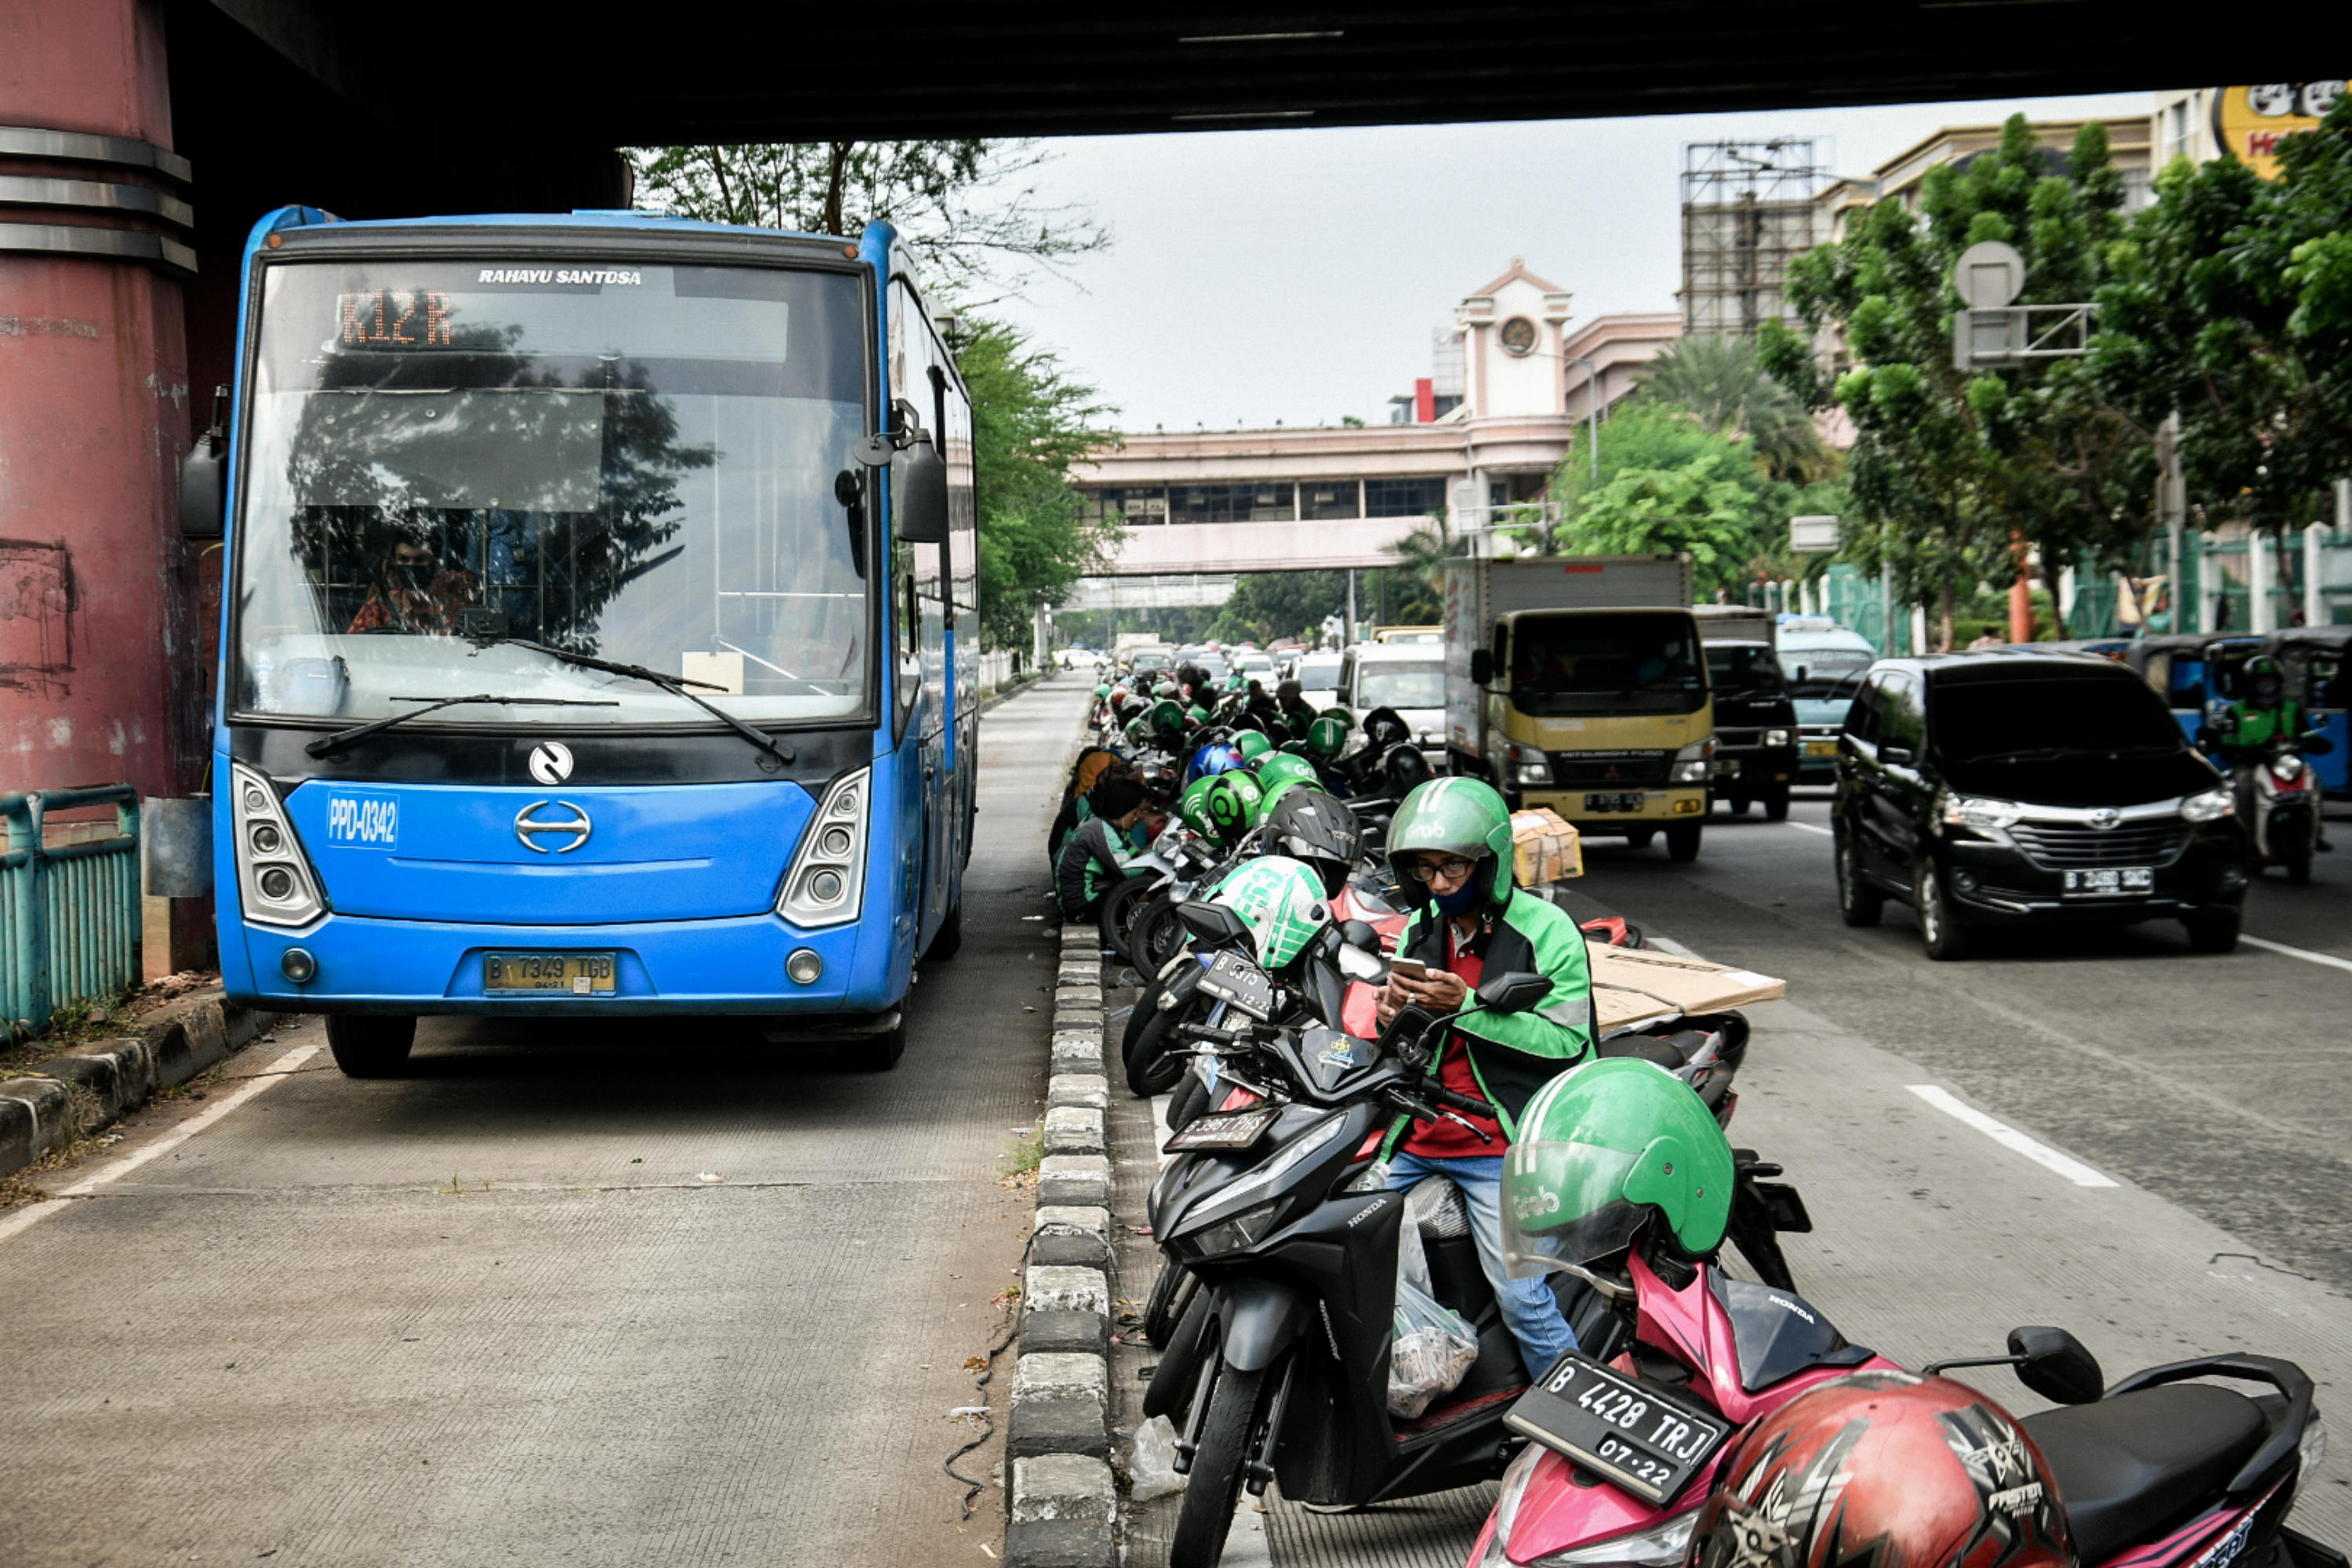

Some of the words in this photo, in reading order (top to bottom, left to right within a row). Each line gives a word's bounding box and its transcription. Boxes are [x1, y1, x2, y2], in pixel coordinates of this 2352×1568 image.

[478, 270, 553, 283] RAHAYU
[555, 270, 641, 285] SANTOSA
[329, 798, 395, 842] PPD-0342
[2064, 871, 2077, 889] B
[490, 956, 502, 978] B
[518, 956, 564, 978] 7349
[575, 956, 610, 978] TGB
[1215, 956, 1228, 971] B
[1185, 1120, 1200, 1134] B
[1347, 1199, 1388, 1228] HONDA
[1769, 1294, 1814, 1324] HONDA
[1549, 1366, 1576, 1392] B
[1577, 1382, 1647, 1428] 4428
[1648, 1414, 1707, 1459] TRJ
